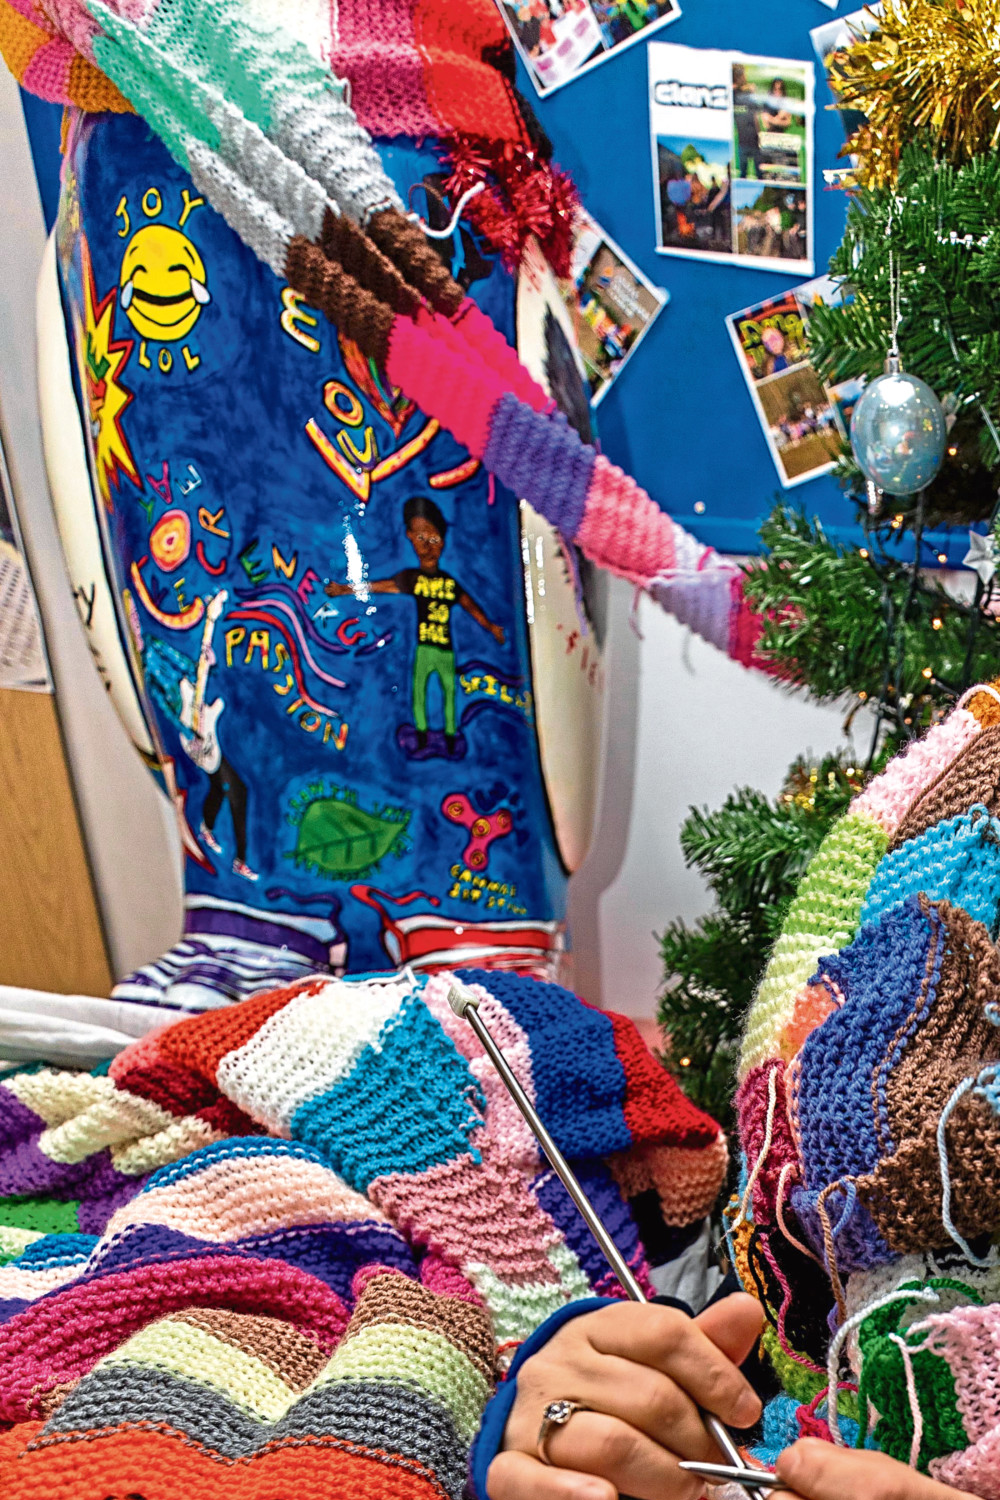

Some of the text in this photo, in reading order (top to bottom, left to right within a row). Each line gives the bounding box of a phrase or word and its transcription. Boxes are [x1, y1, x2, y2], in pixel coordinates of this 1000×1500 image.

[115, 187, 204, 237] JOY
[139, 341, 200, 372] LOL
[225, 627, 348, 749] PASSION
